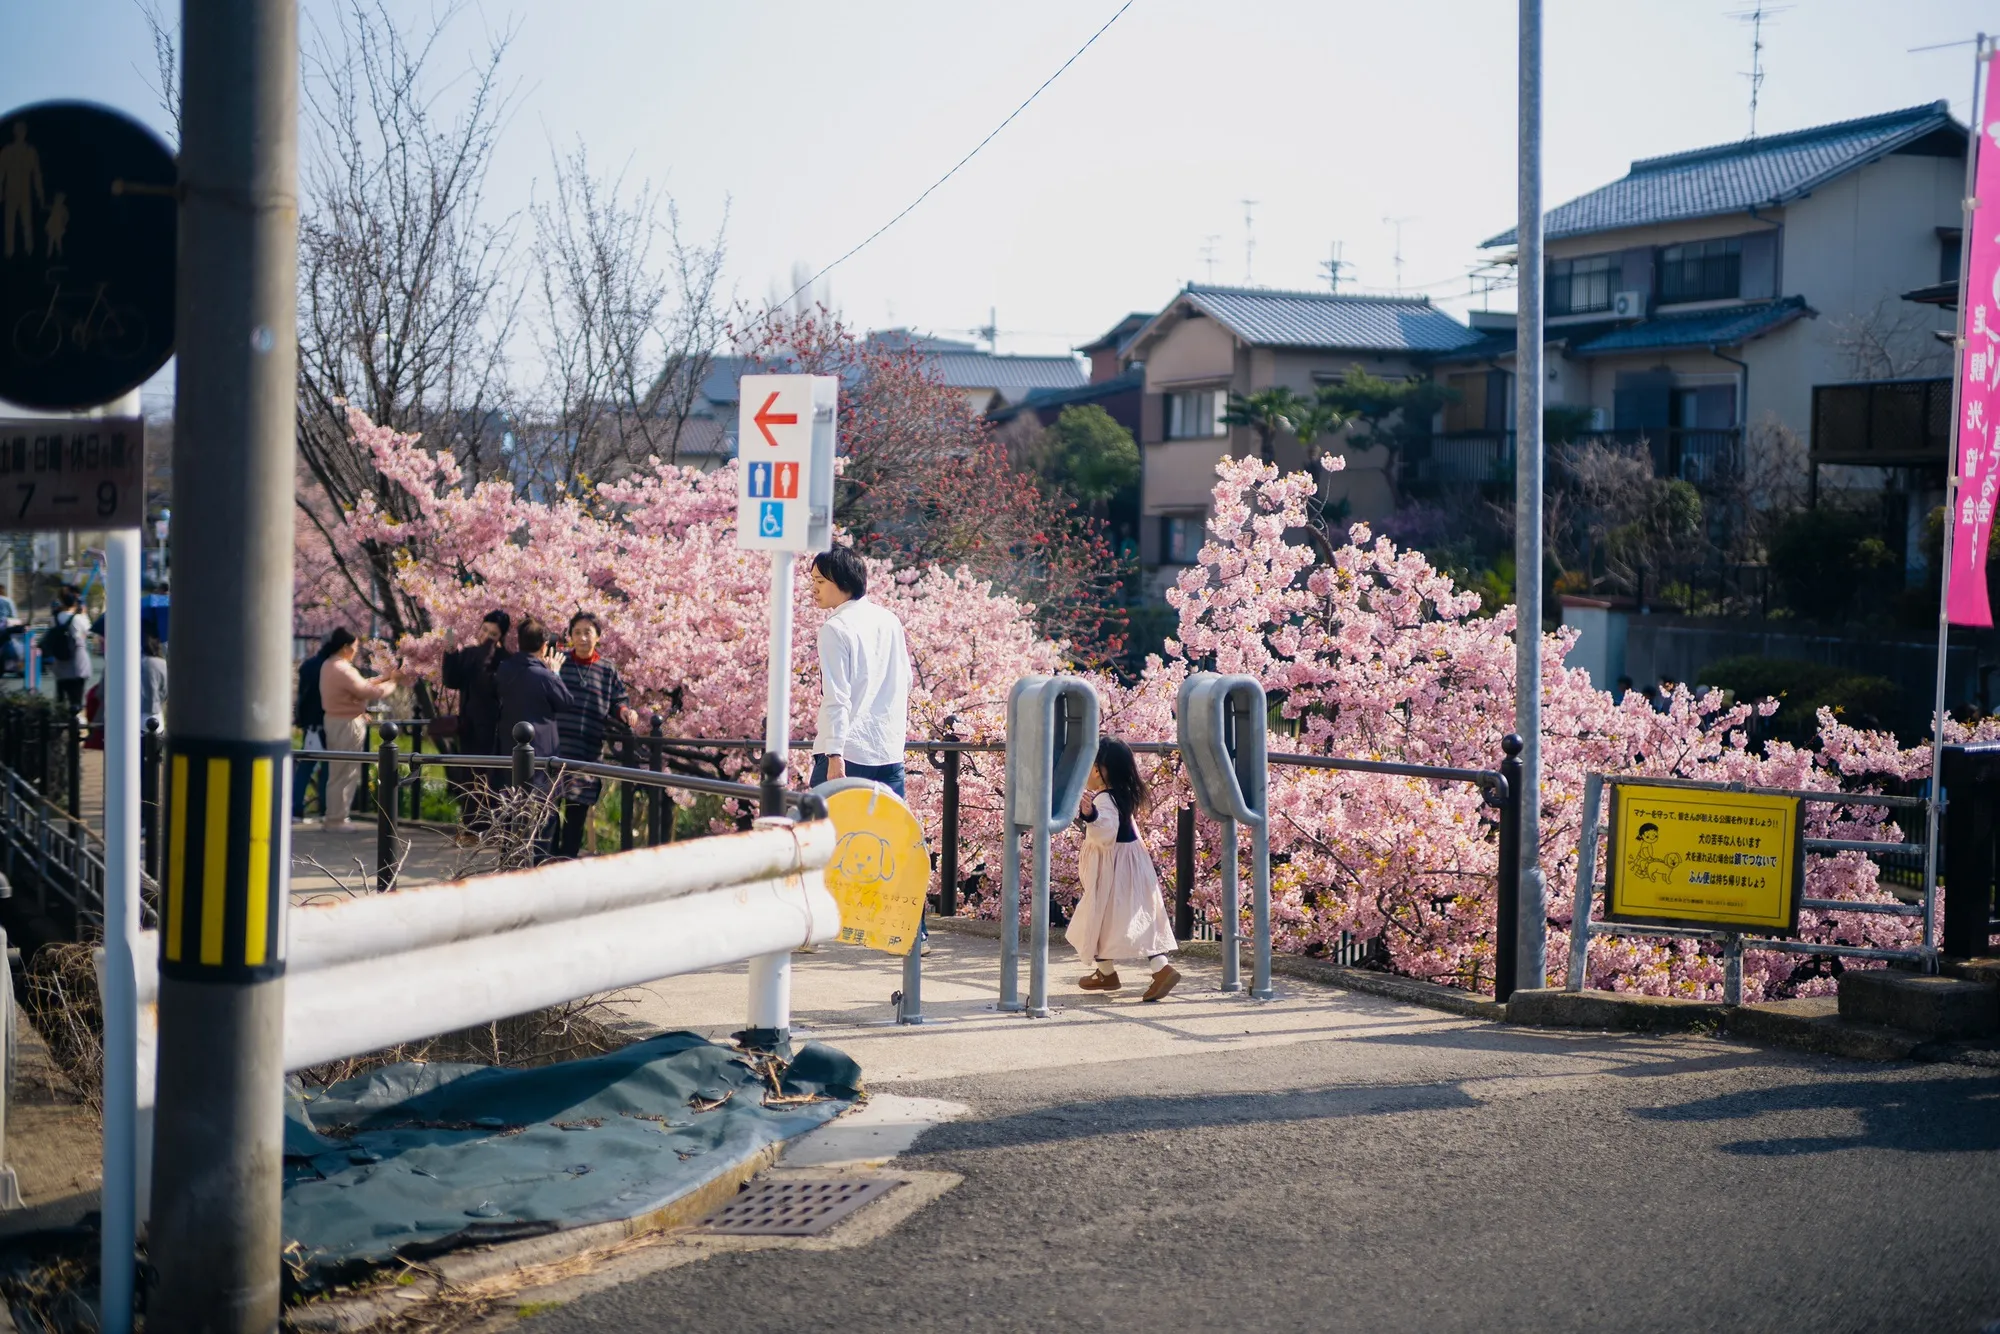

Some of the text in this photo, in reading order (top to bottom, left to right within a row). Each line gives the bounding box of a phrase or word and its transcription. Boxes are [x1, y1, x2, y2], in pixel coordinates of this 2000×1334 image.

[1699, 834, 1762, 849] 犬の苦手な人もいます
[1690, 872, 1766, 889] ふん便は持ち帰りましょう
